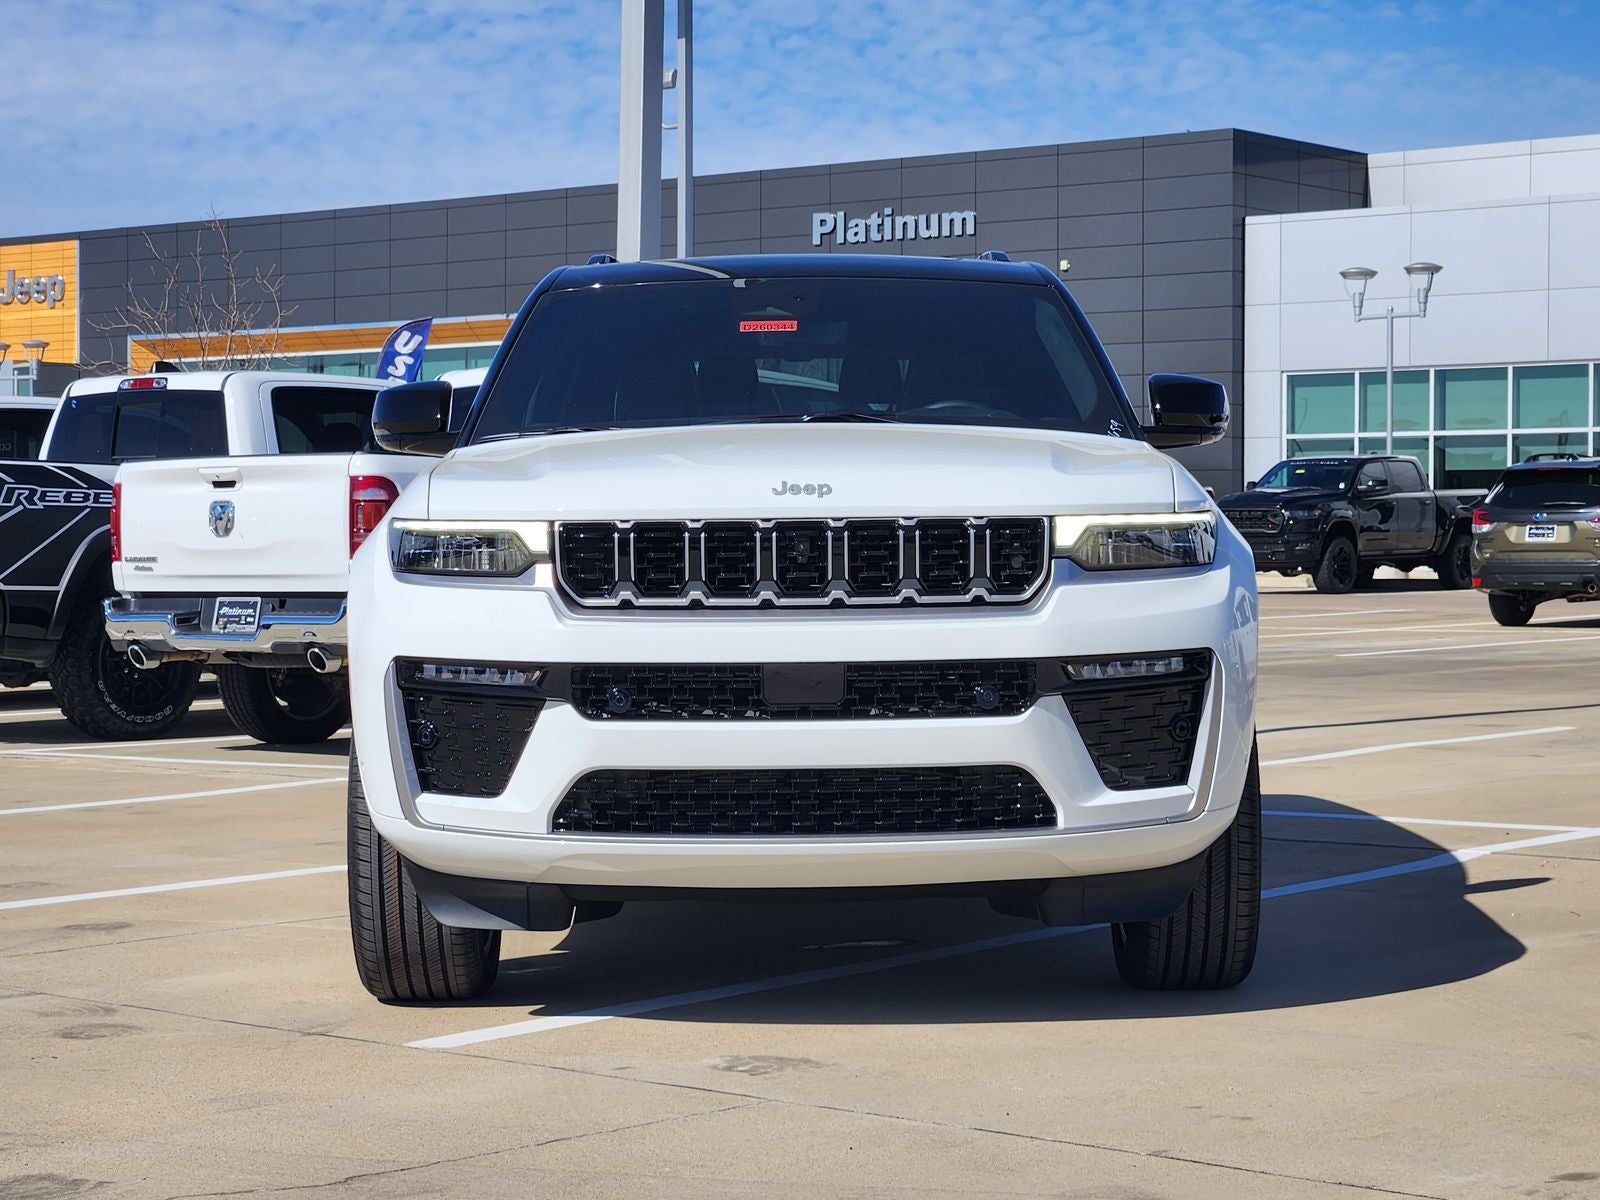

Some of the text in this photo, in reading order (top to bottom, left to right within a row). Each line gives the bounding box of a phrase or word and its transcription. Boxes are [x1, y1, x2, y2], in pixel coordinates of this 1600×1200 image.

[812, 207, 977, 247] Platinum
[0, 269, 65, 309] Jeep
[0, 484, 113, 509] REBE
[771, 480, 833, 499] Jeep
[219, 606, 255, 616] Platinum
